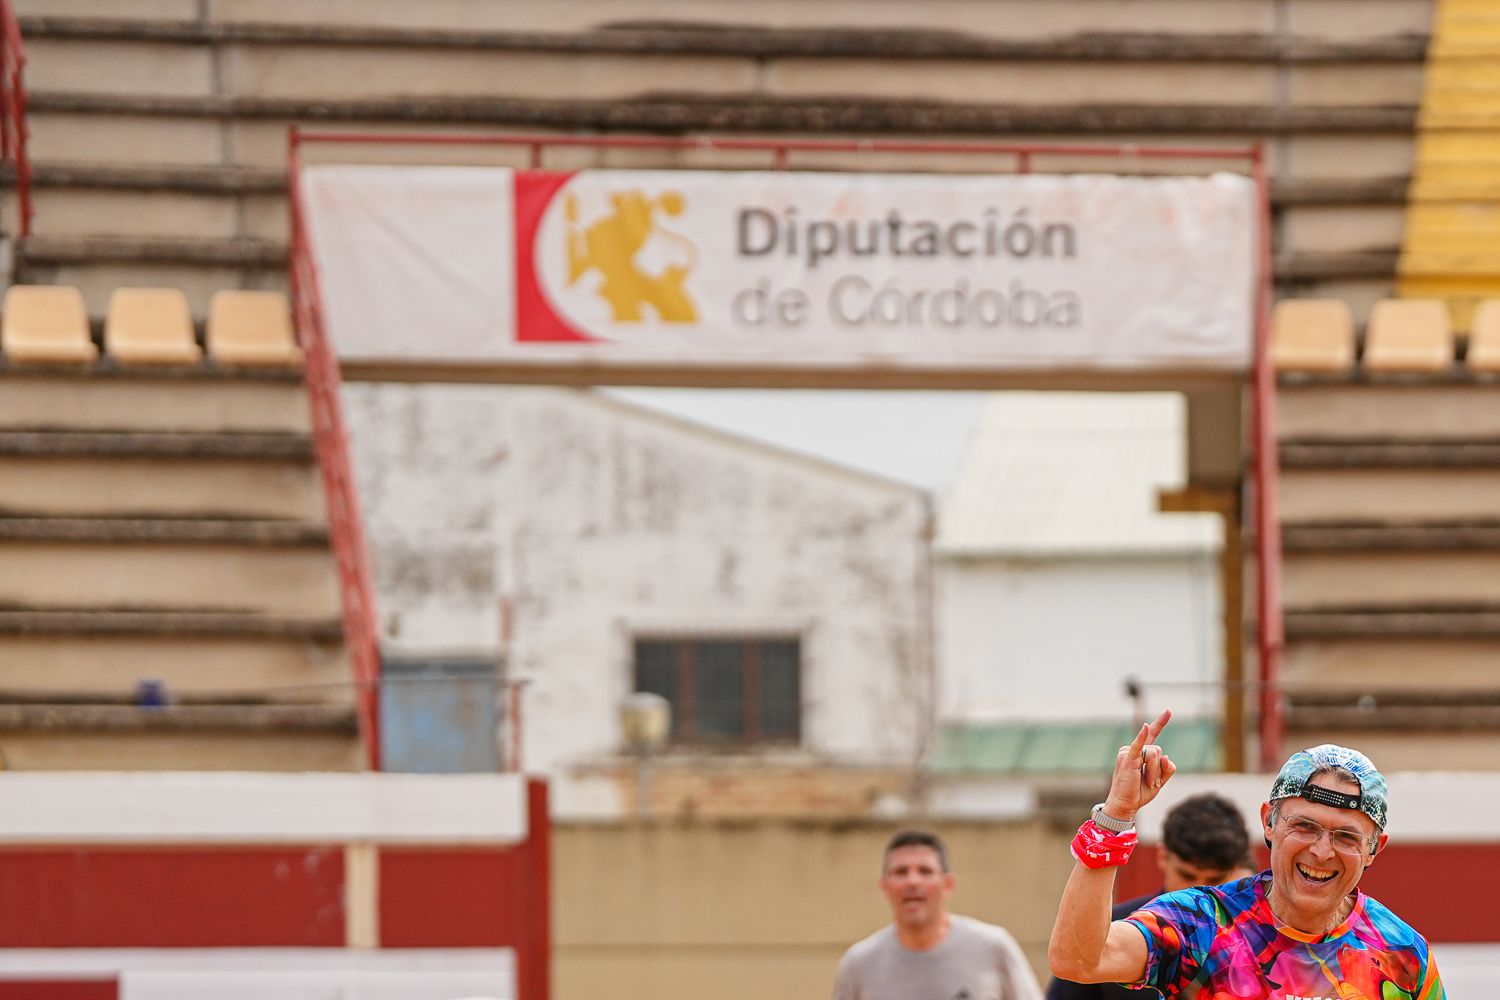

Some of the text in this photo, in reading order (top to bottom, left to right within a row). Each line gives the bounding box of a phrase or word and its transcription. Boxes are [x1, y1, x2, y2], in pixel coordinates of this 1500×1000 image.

[736, 205, 1077, 270] Diputación
[731, 274, 1082, 329] de Córdoba
